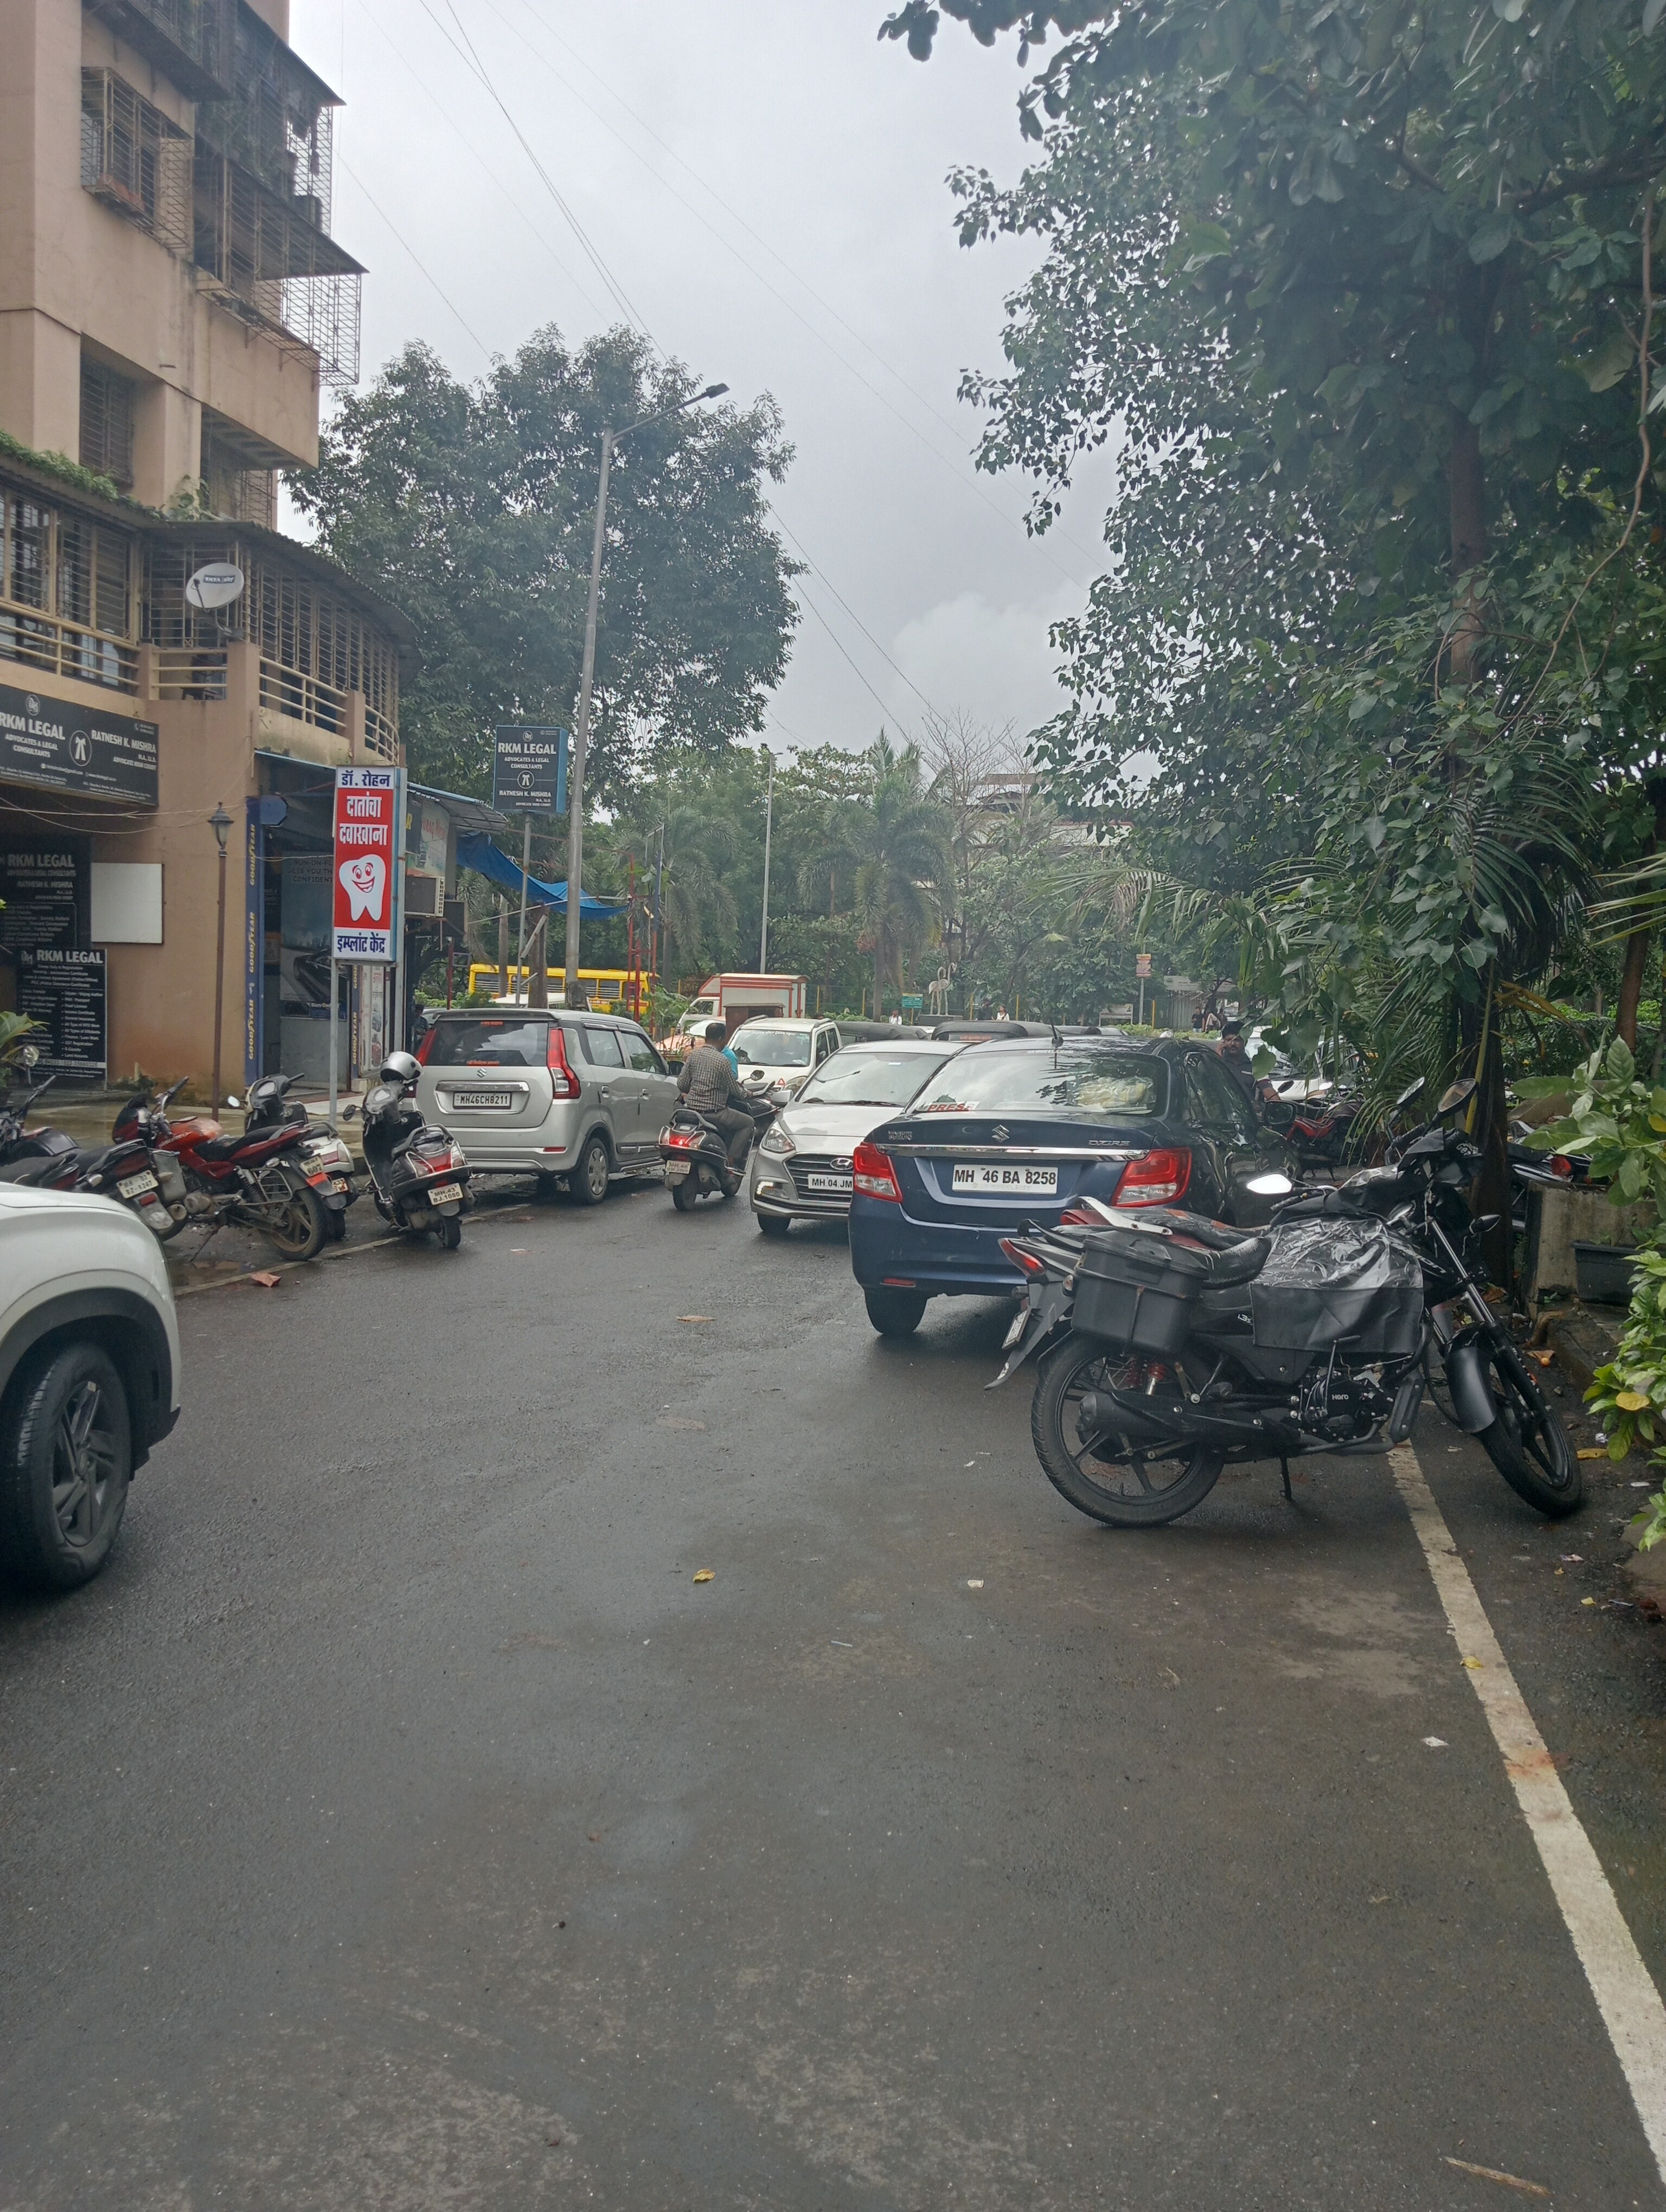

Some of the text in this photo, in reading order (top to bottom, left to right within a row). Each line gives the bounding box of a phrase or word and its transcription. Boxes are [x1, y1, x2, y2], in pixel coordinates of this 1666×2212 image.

[0, 712, 66, 740] RKM LEGAL
[5, 734, 37, 745] ADVOCATES
[42, 741, 59, 750] LEGAL
[91, 730, 157, 754] RATNESH K. MISHRA
[498, 743, 556, 754] RKM LEGAL
[13, 745, 51, 758] CONSULTANTS
[342, 770, 390, 787] डॉ. रोहन
[347, 791, 382, 818] दातांचा
[339, 823, 388, 845] दवाखाना
[8, 854, 75, 867] RKM LEGAL
[337, 931, 386, 953] इम्प्लांट केंद्र
[37, 950, 103, 963] RKM LEGAL
[460, 1095, 508, 1104] MH46CH8211
[954, 1169, 1056, 1185] MH 46 BA 8258
